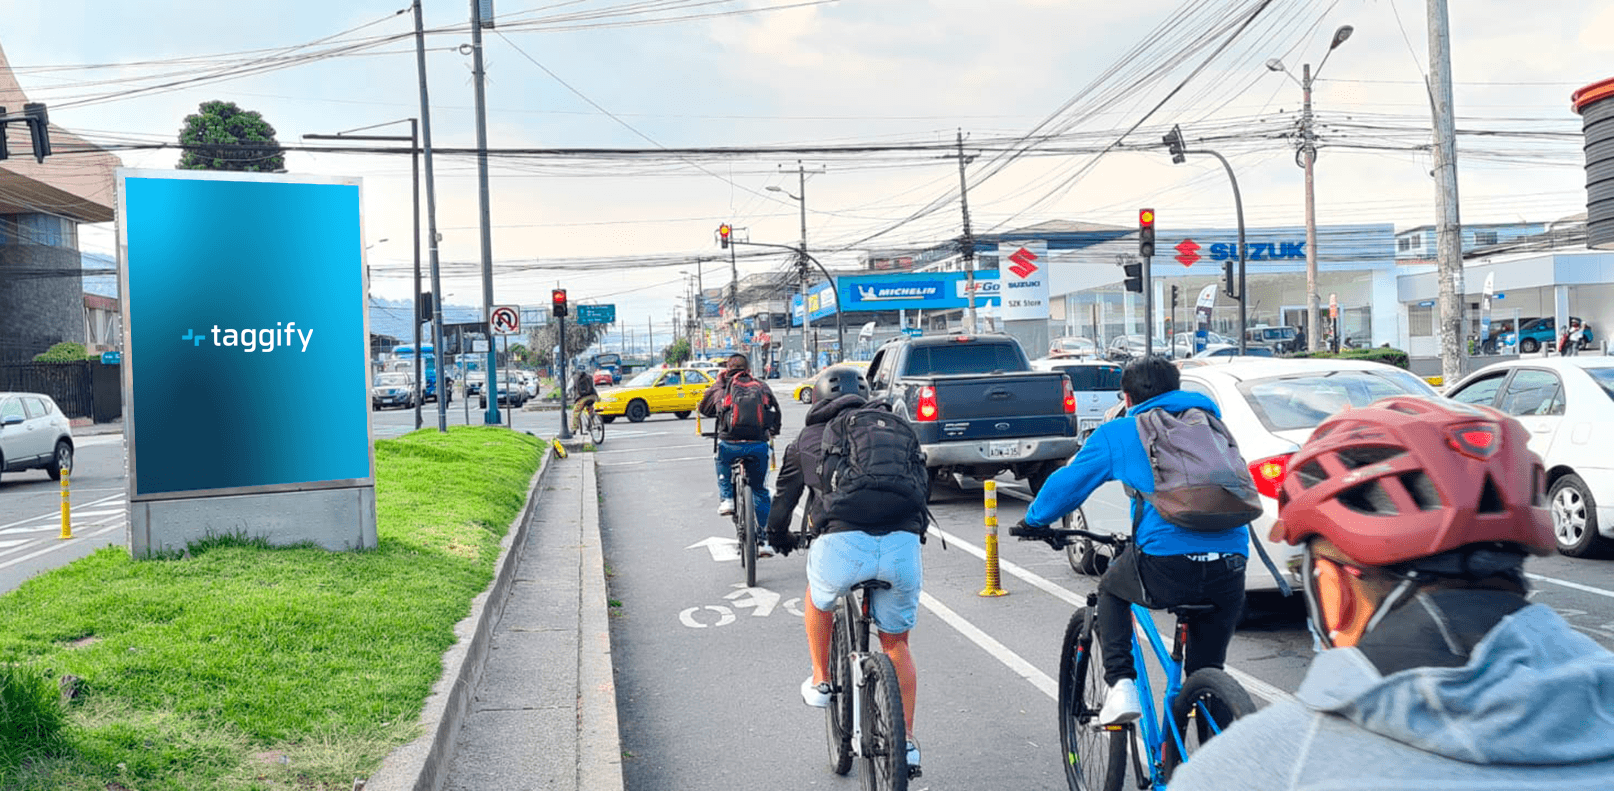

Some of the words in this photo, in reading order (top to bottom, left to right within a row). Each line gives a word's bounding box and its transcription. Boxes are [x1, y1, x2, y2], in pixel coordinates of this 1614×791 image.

[1210, 242, 1307, 261] SUZUK
[879, 287, 936, 296] MICHELIN
[1008, 281, 1040, 289] SUZUKI
[210, 321, 314, 353] taggify
